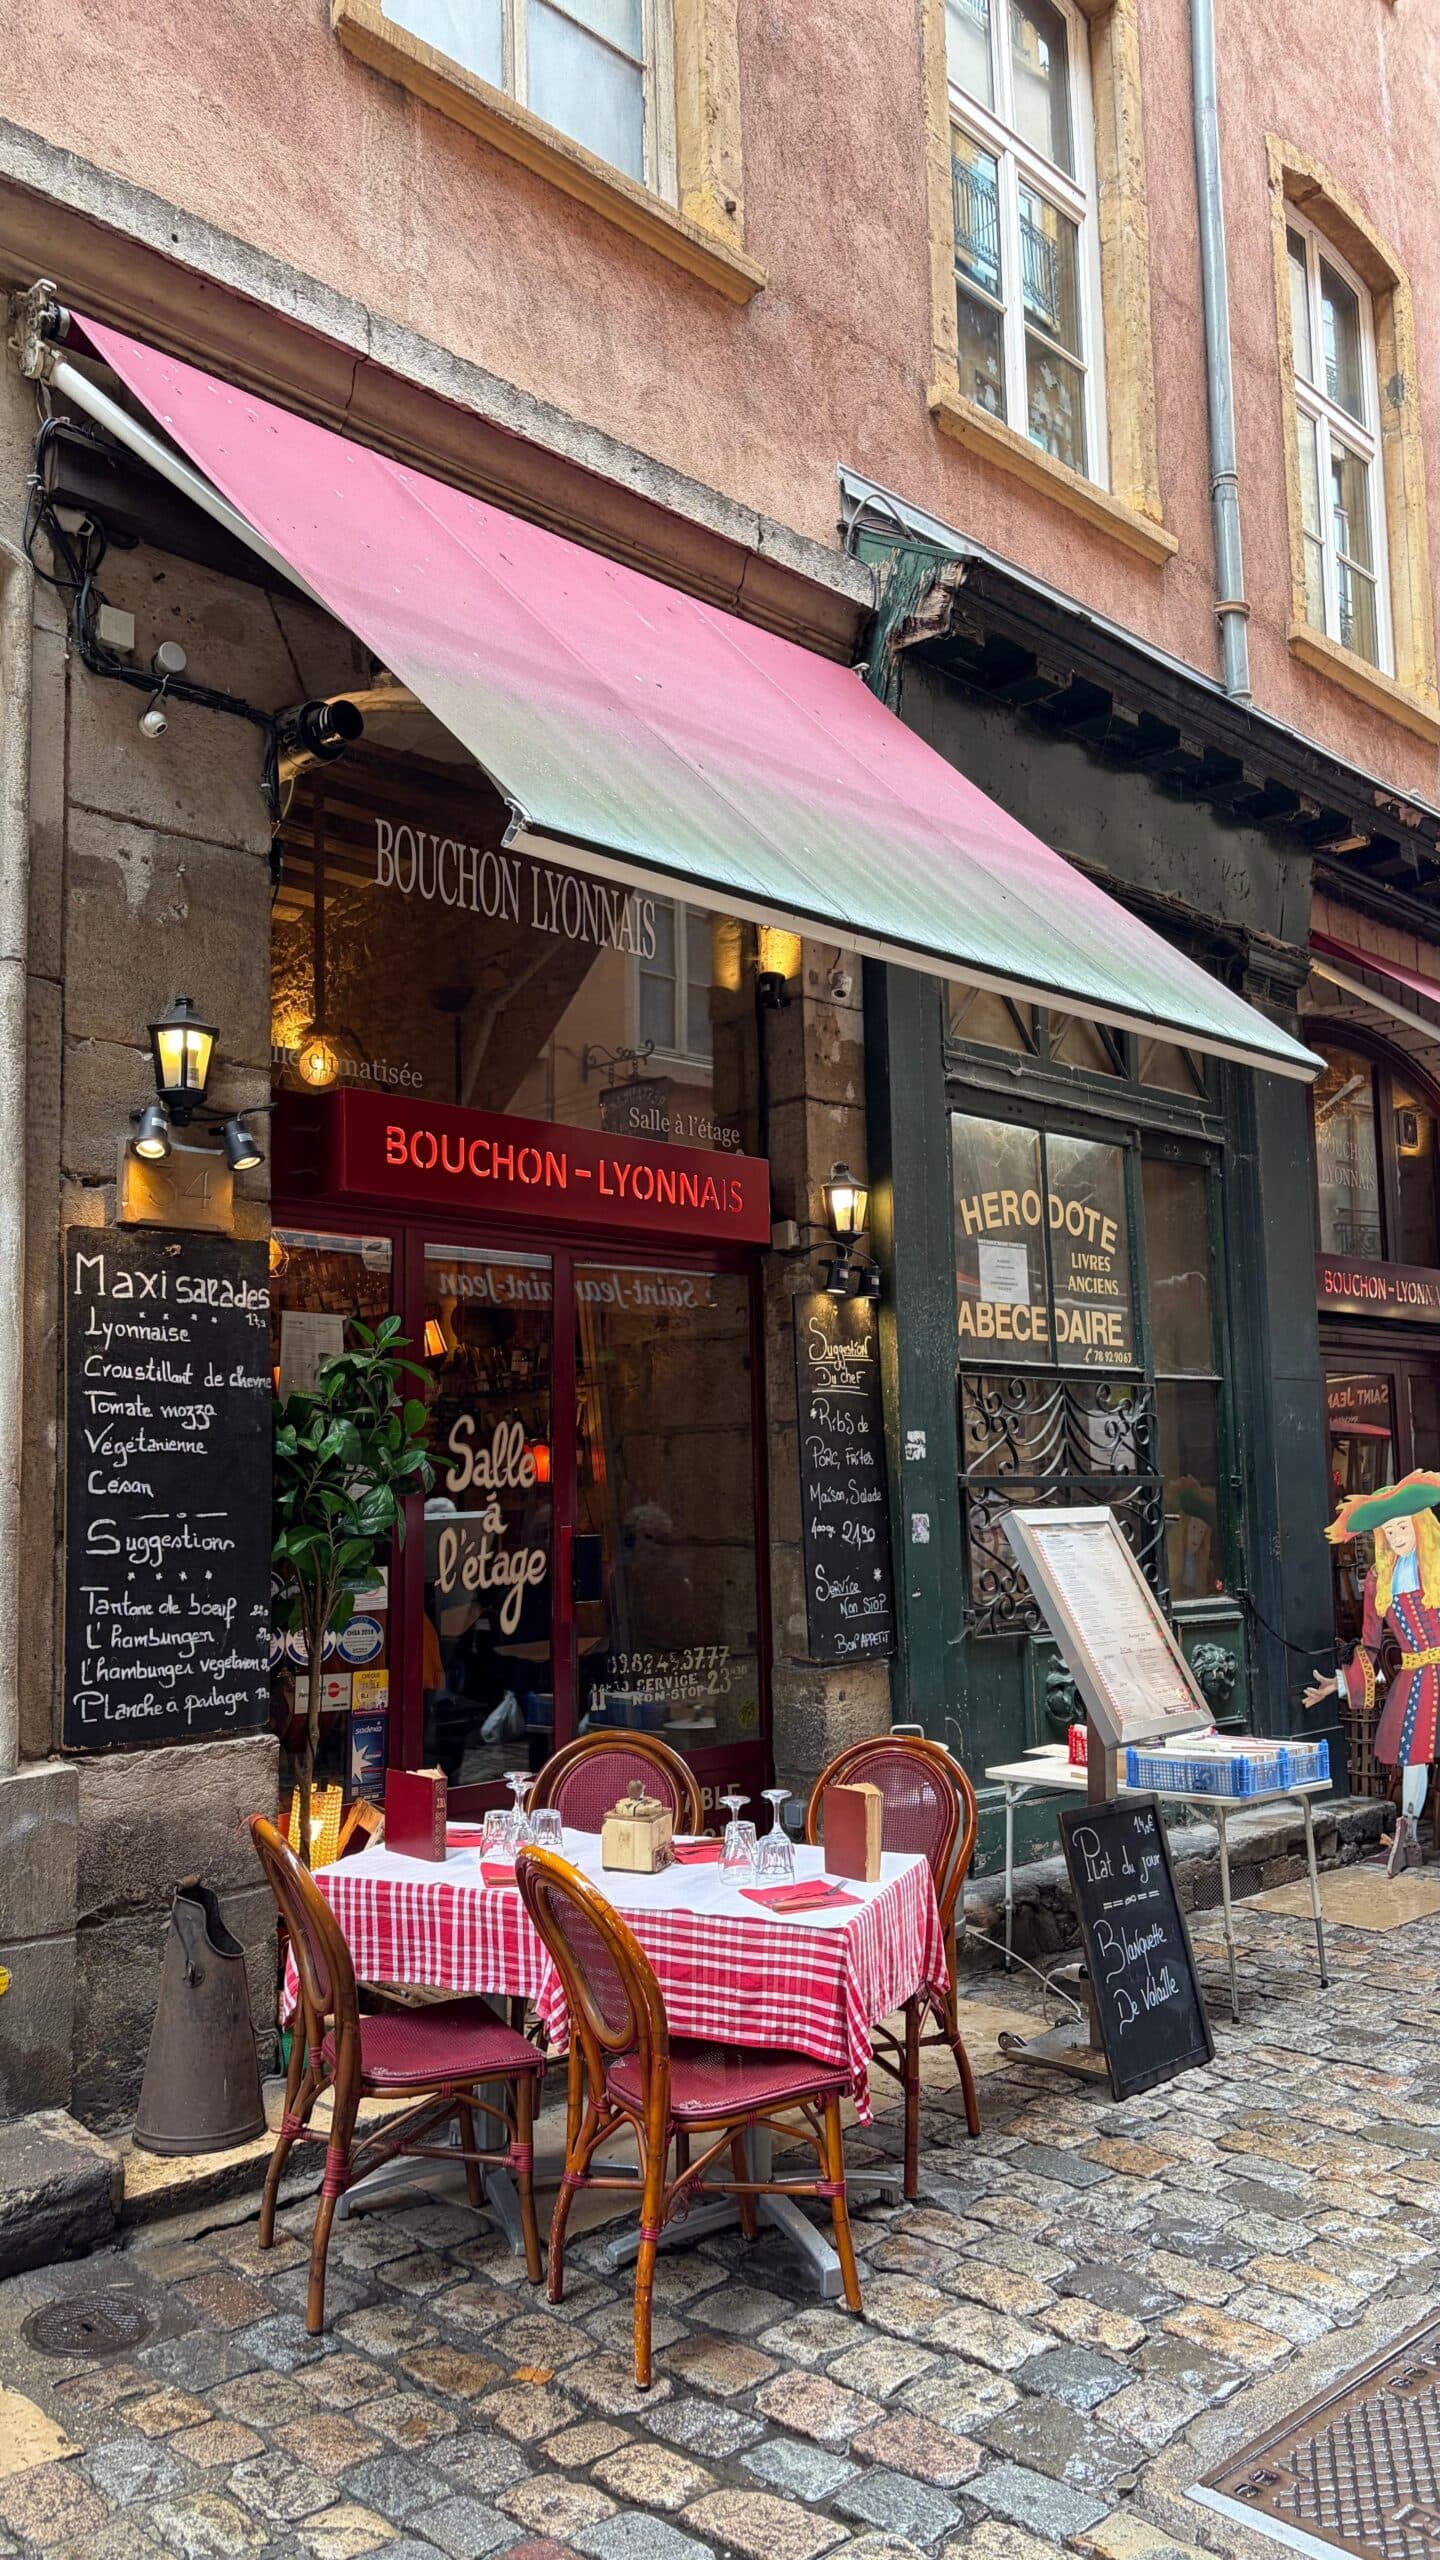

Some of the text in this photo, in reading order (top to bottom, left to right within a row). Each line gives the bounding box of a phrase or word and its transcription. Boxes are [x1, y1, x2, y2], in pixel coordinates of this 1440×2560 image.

[375, 817, 657, 960] BOUCHON LYONNAIS
[628, 1106, 671, 1133] Salle
[674, 1113, 684, 1136] à
[1321, 1163, 1377, 1192] LYONNAIS
[73, 1251, 271, 1310] Maxi salades
[1070, 1251, 1111, 1273] LIVRES
[1068, 1275, 1119, 1297] ANCIENS
[84, 1305, 192, 1350] Lyonnaise
[83, 1354, 194, 1385] Croustillant
[203, 1361, 225, 1388] de
[82, 1389, 218, 1431] Tomate mozza
[857, 1415, 870, 1433] de
[84, 1422, 209, 1468] Végétarienne
[445, 1413, 536, 1493] Salle
[434, 1525, 547, 1636] l'étage
[79, 1586, 154, 1616] Tartare
[158, 1593, 182, 1615] de
[183, 1686, 249, 1725] partager
[1121, 1845, 1136, 1875] du
[1140, 1854, 1161, 1884] jour
[1093, 1919, 1168, 1985] Blanquette
[1113, 1965, 1180, 2035] De Volaille
